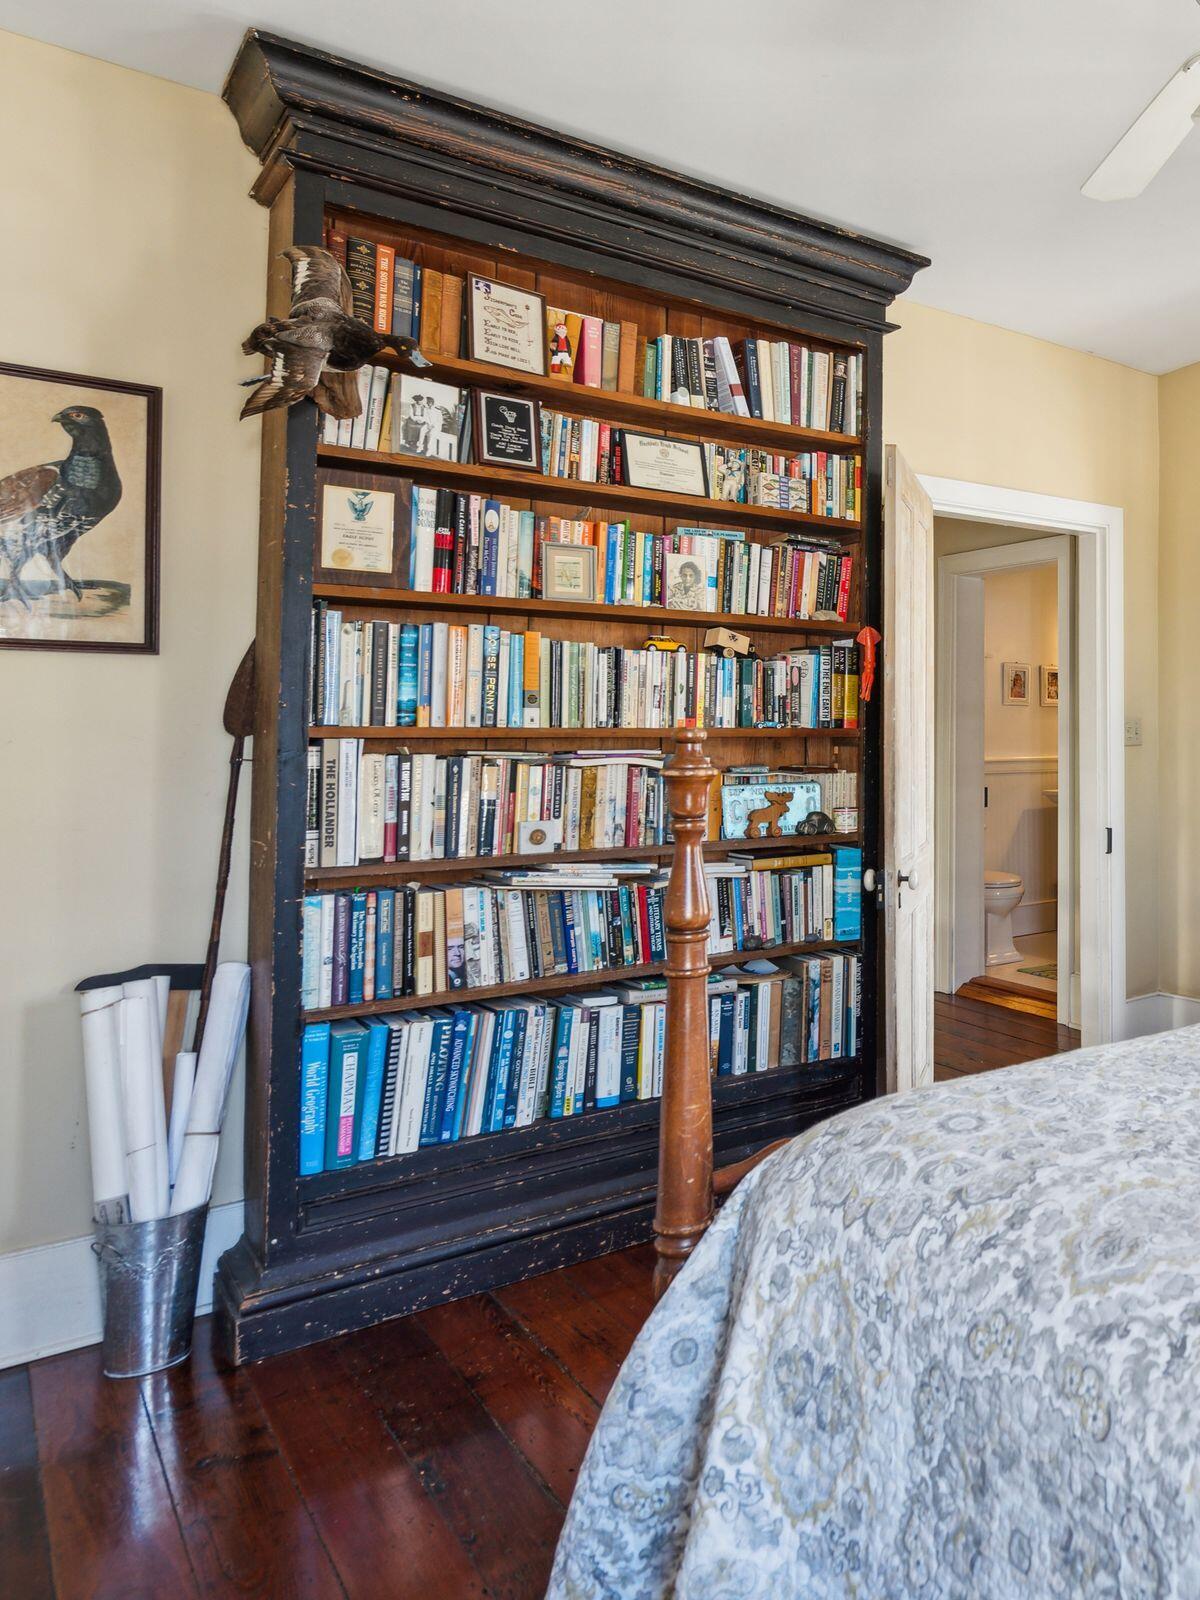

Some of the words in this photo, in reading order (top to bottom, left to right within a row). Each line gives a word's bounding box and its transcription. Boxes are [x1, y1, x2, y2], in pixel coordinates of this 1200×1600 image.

[380, 257, 388, 271] THE
[380, 272, 388, 292] SOUTH
[379, 294, 388, 308] WAS
[378, 308, 387, 330] RIGHT!
[488, 634, 496, 669] LOUISE
[823, 658, 830, 666] TO
[486, 677, 495, 711] PENNY
[326, 759, 336, 779] THE
[402, 762, 410, 770] THE
[324, 783, 335, 848] HOLLANDER
[434, 1025, 452, 1092] PILOTING
[451, 1038, 463, 1069] ADVANCED
[306, 1061, 321, 1087] World
[528, 1068, 536, 1090] BIBLE
[556, 1059, 569, 1080] Beginning
[343, 1055, 356, 1113] CHAPMAN
[445, 1070, 459, 1112] SKYWATCHING
[555, 1082, 567, 1098] Algebra
[301, 1089, 321, 1135] Geography
[421, 1104, 430, 1135] HANDLING
